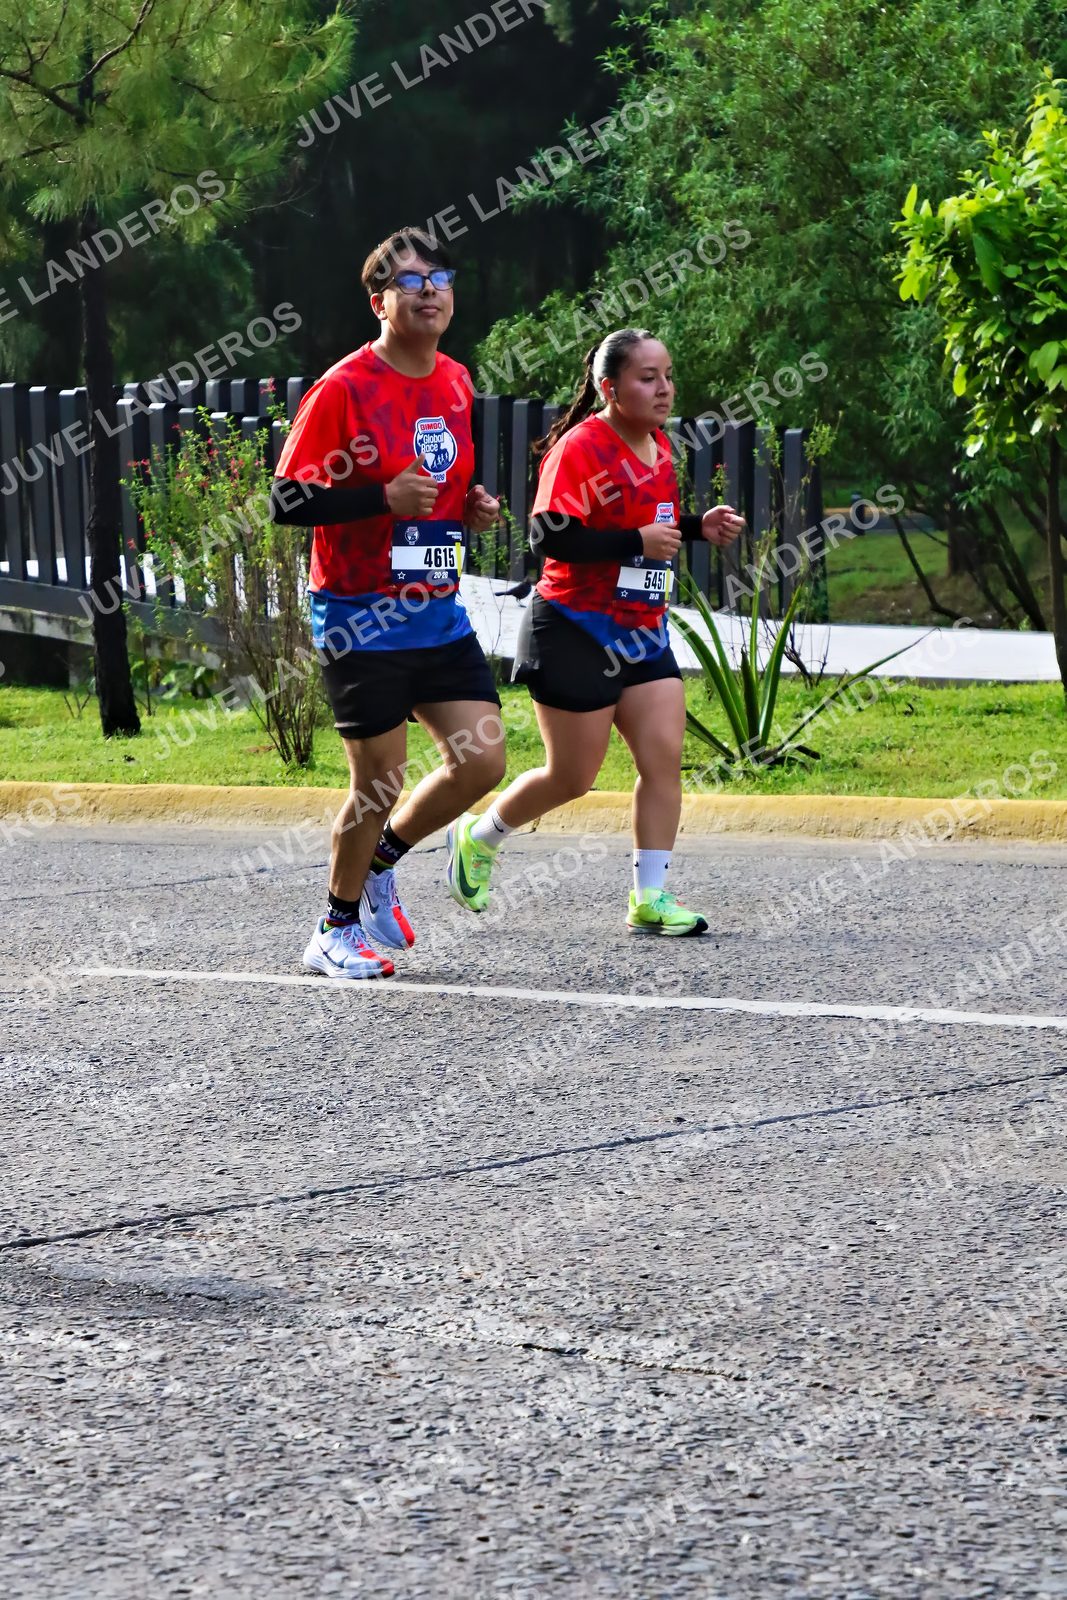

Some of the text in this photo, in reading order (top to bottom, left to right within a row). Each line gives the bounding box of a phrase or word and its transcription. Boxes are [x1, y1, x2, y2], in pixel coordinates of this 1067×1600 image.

[423, 434, 444, 444] Global
[421, 444, 438, 453] Race
[423, 547, 455, 568] 4615
[643, 570, 666, 590] 5451
